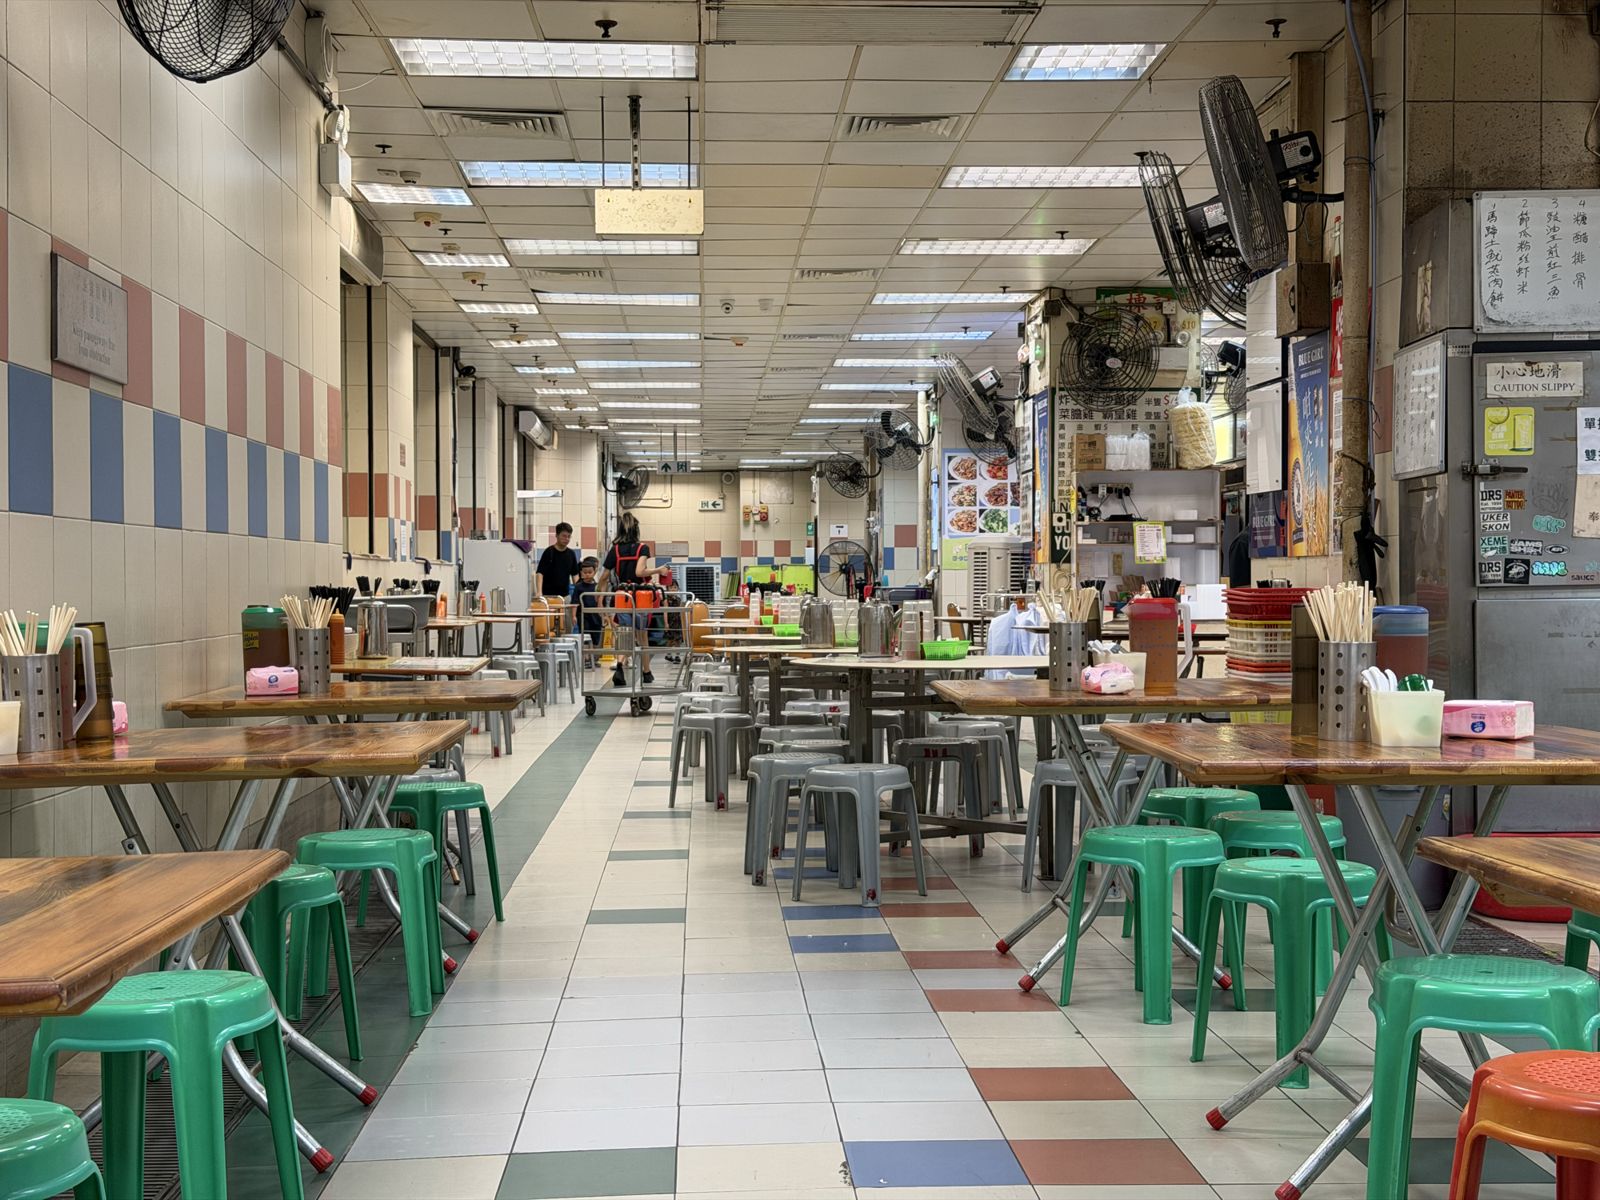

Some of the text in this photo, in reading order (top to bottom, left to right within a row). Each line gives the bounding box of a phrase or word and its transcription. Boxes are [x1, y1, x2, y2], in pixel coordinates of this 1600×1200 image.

[1298, 347, 1323, 367] BLUE GIRL
[1496, 363, 1562, 380] 小心地滑
[1493, 382, 1576, 393] CAUTION SLIPPY
[1480, 489, 1502, 501] DRS
[1482, 513, 1509, 521] UKER
[1482, 523, 1510, 531] SKON
[1480, 536, 1507, 546] XEME
[1479, 562, 1501, 573] DRS
